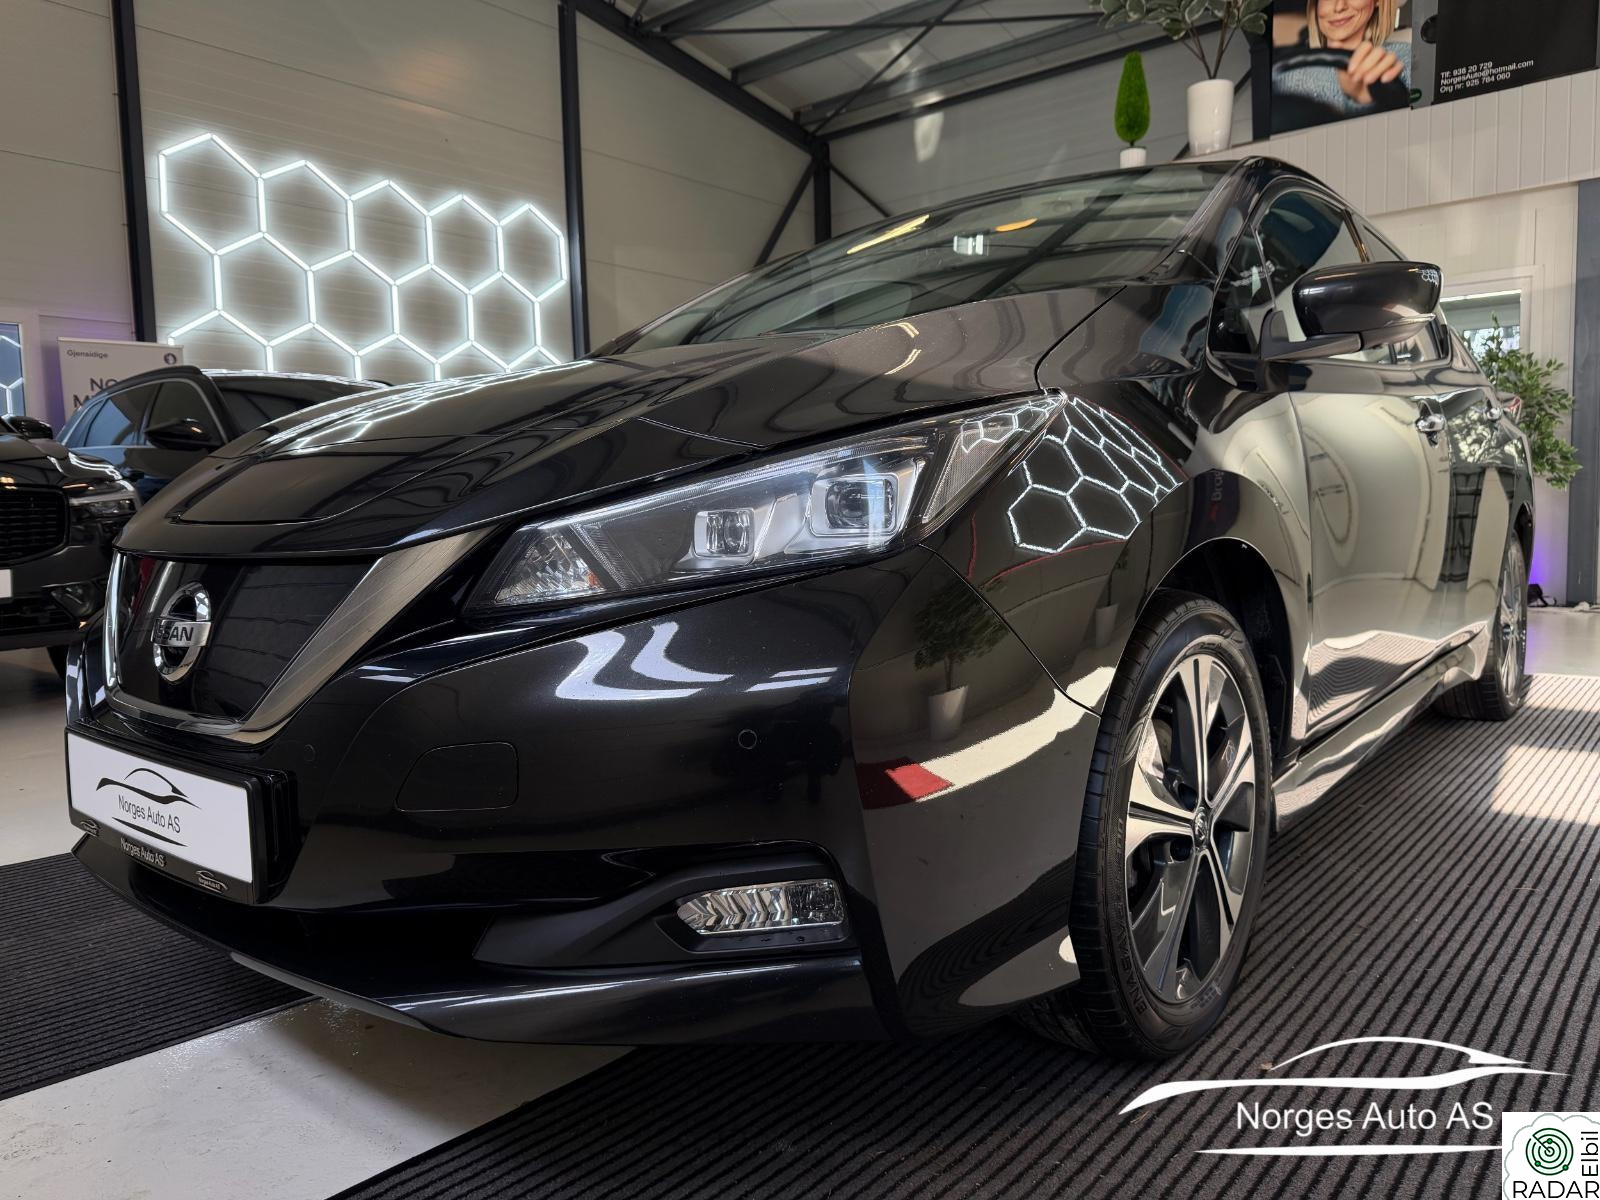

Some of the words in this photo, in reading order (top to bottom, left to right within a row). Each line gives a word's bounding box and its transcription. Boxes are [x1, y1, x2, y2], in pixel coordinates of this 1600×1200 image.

[1440, 59, 1534, 86] NorgesAuto@hotmail.com
[1468, 64, 1478, 73] 20
[1440, 85, 1454, 94] Org
[66, 349, 109, 359] Gjensidige
[118, 794, 146, 820] Norges
[146, 806, 166, 828] Auto
[167, 814, 181, 834] AS
[120, 837, 141, 857] Norges
[140, 847, 155, 863] Auto
[154, 853, 165, 867] AS
